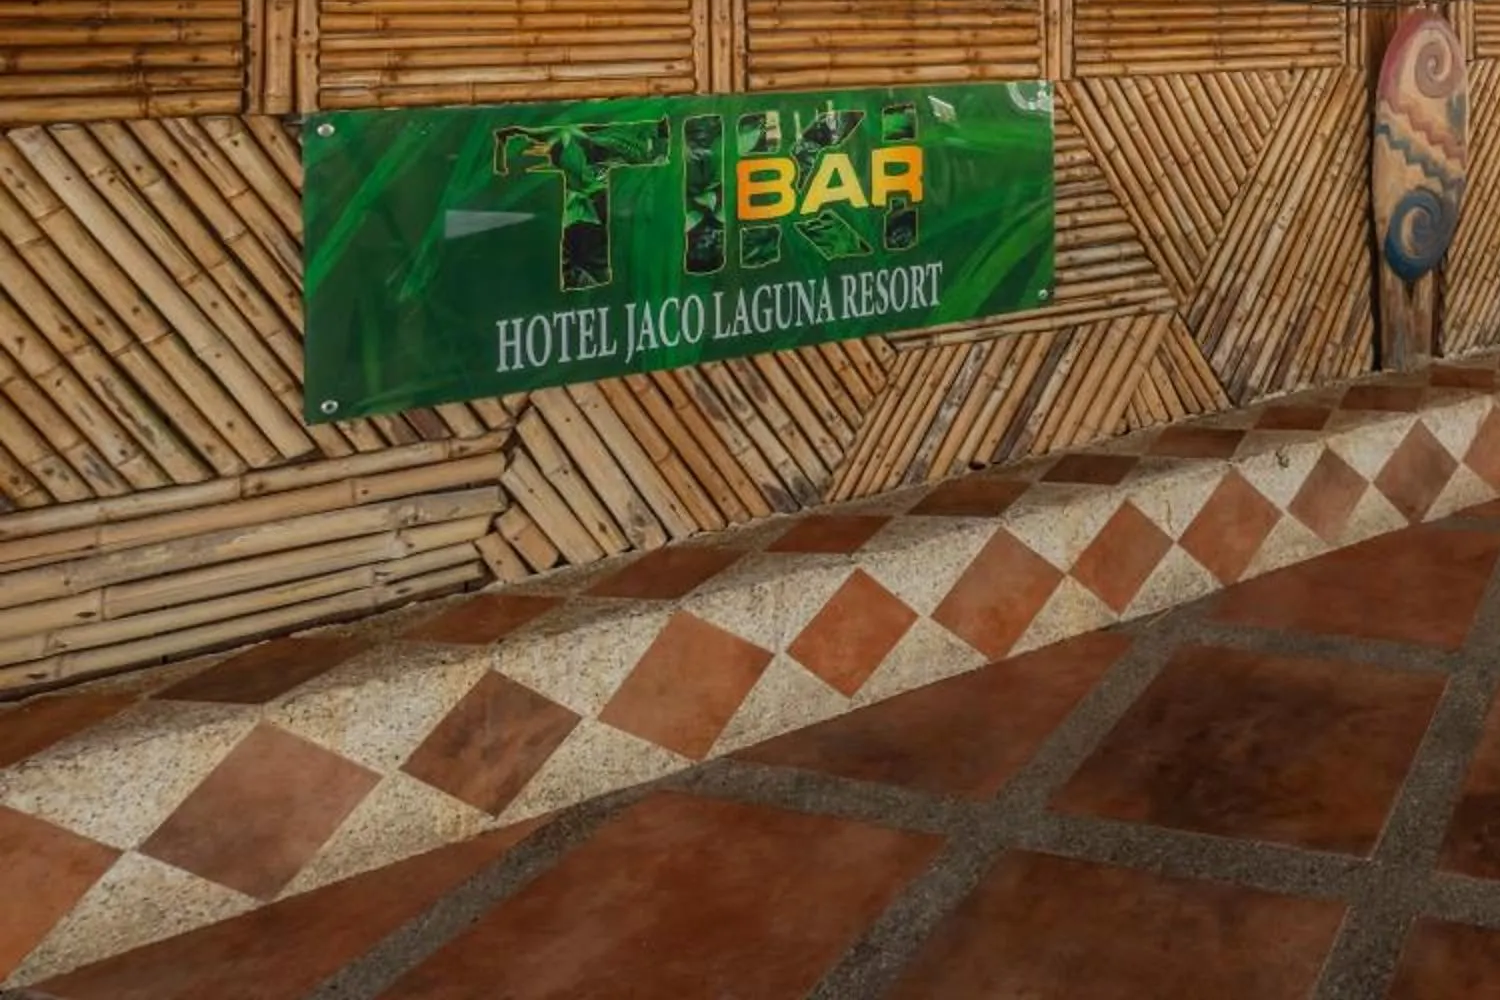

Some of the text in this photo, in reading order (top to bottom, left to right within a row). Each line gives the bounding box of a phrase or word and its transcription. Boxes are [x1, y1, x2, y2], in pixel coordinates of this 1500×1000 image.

[493, 102, 924, 293] TIKI BAR
[495, 260, 944, 373] HOTEL JACO LAGUNA RESORT
